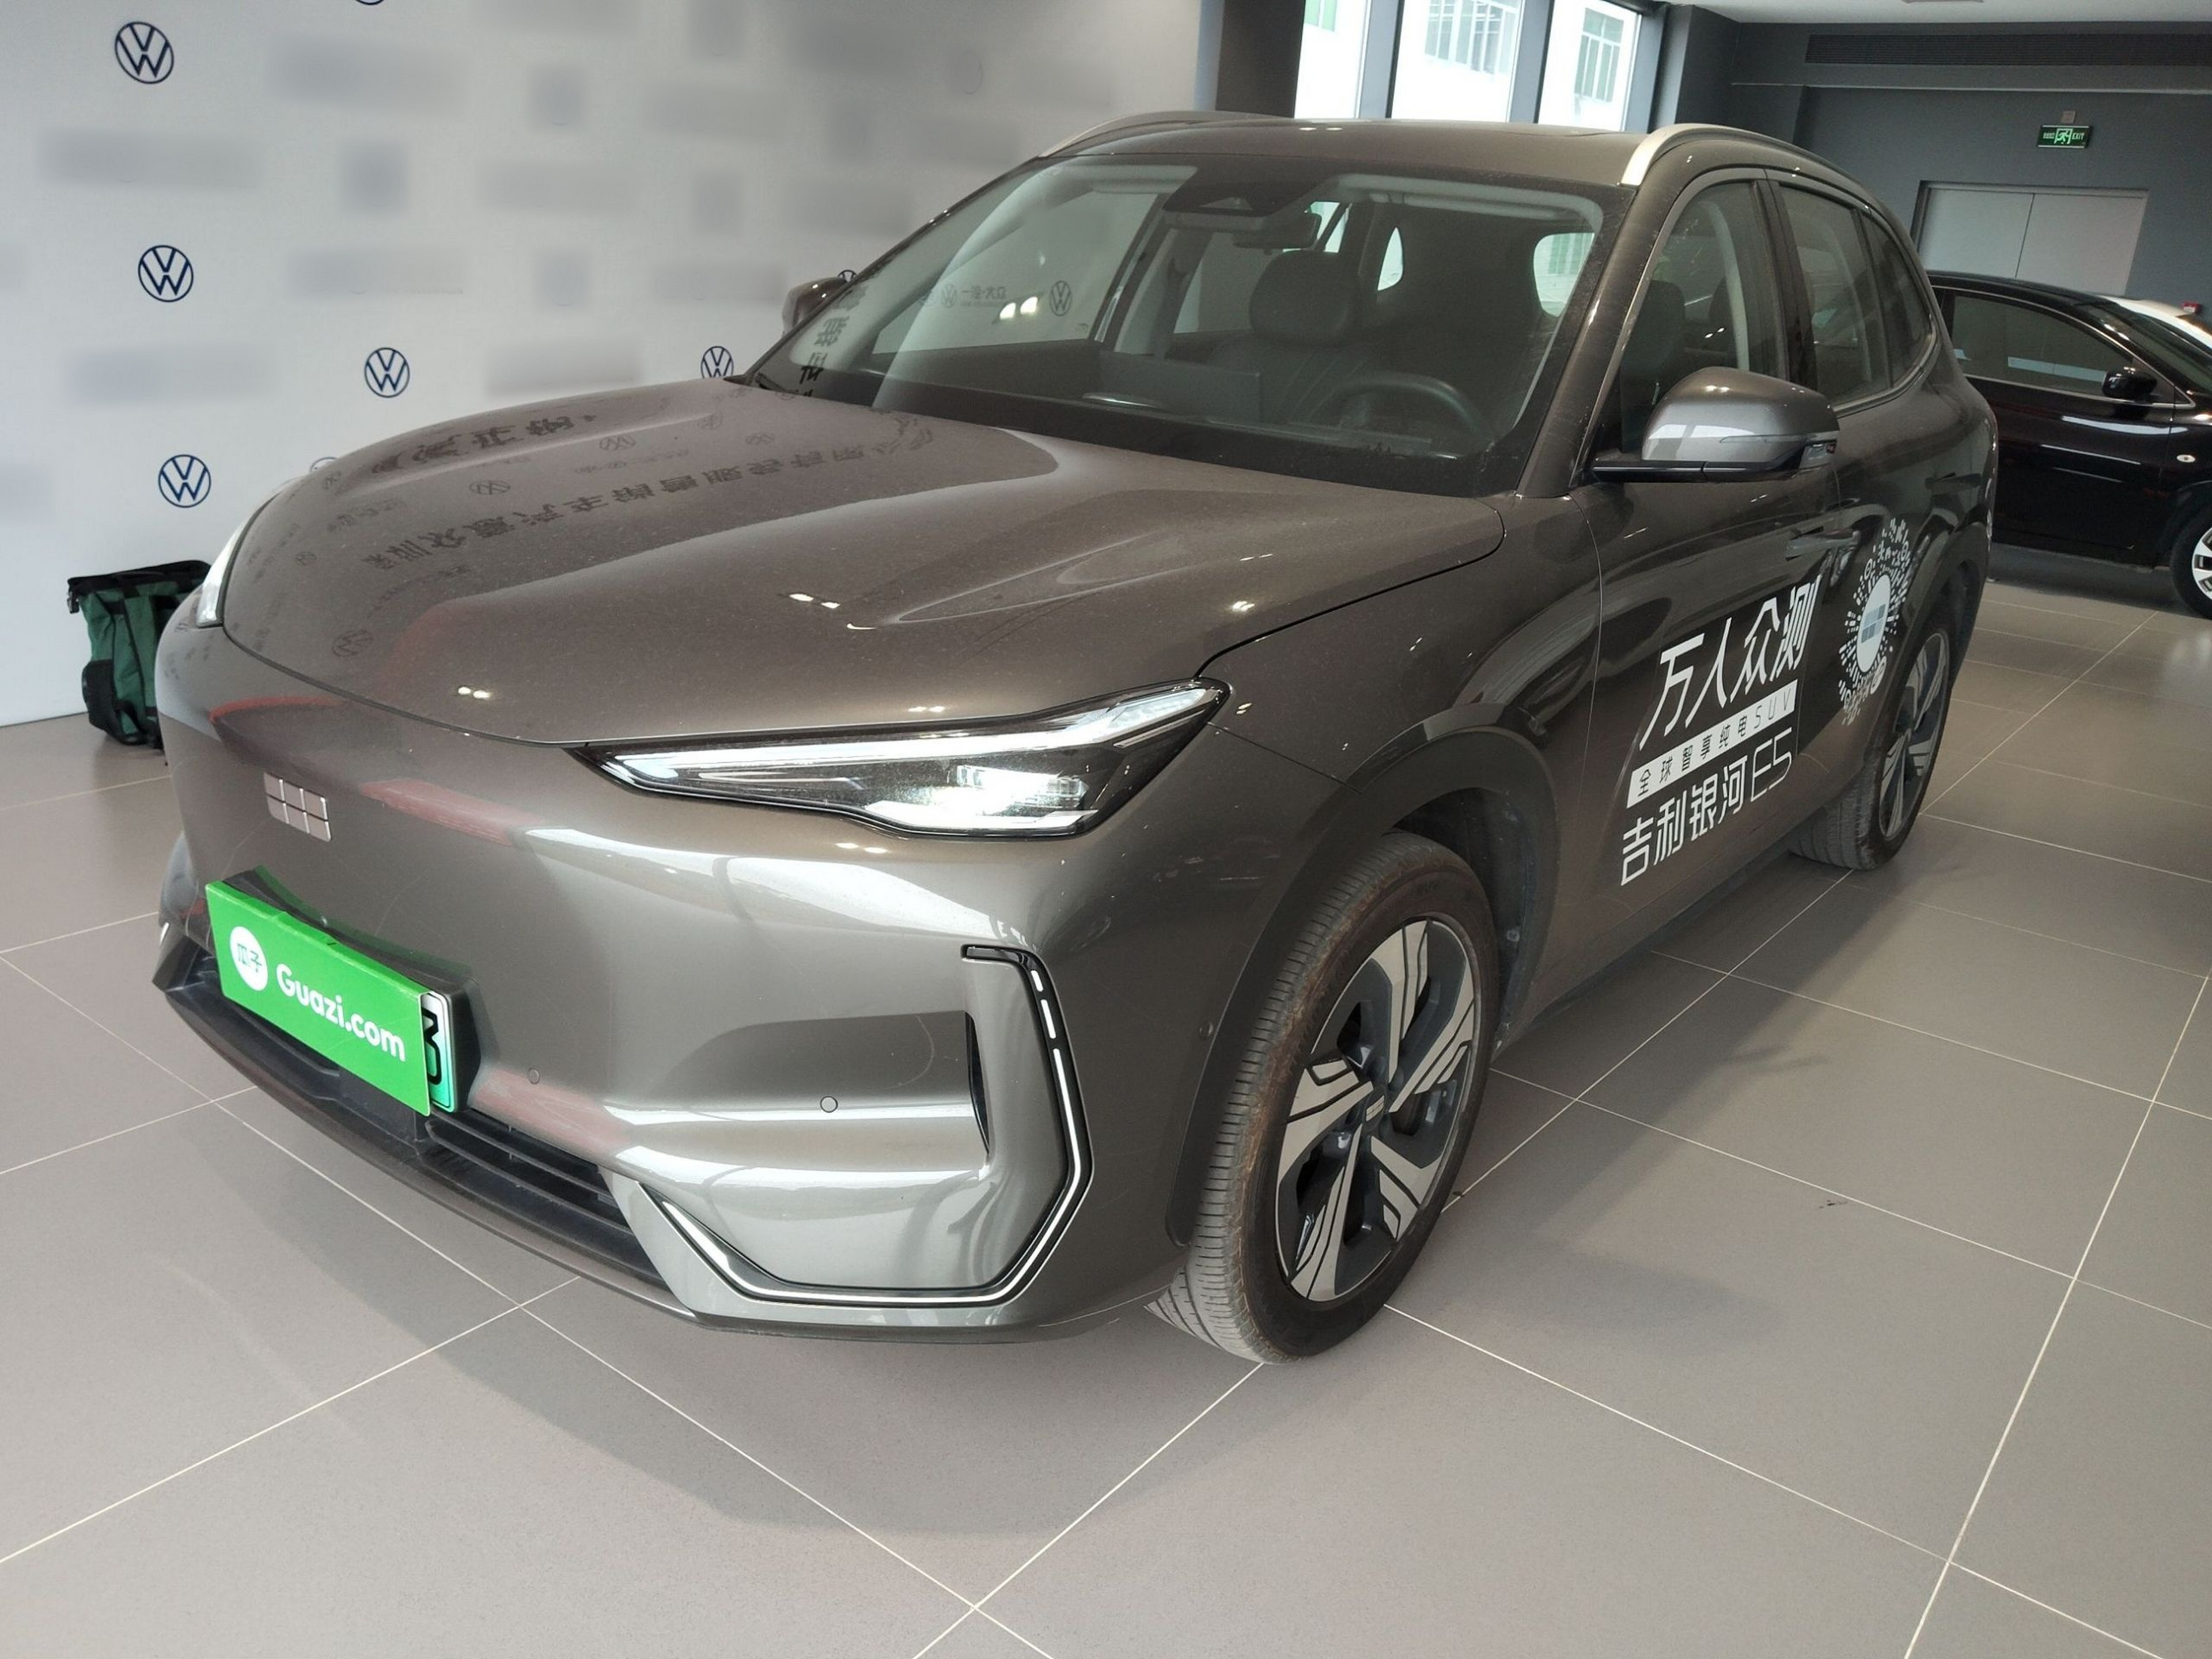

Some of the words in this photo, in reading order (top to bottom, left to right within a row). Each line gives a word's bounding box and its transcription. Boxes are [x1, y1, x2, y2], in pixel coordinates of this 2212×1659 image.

[1639, 574, 1822, 751] 万人众测
[276, 963, 406, 1062] Guazi.com
